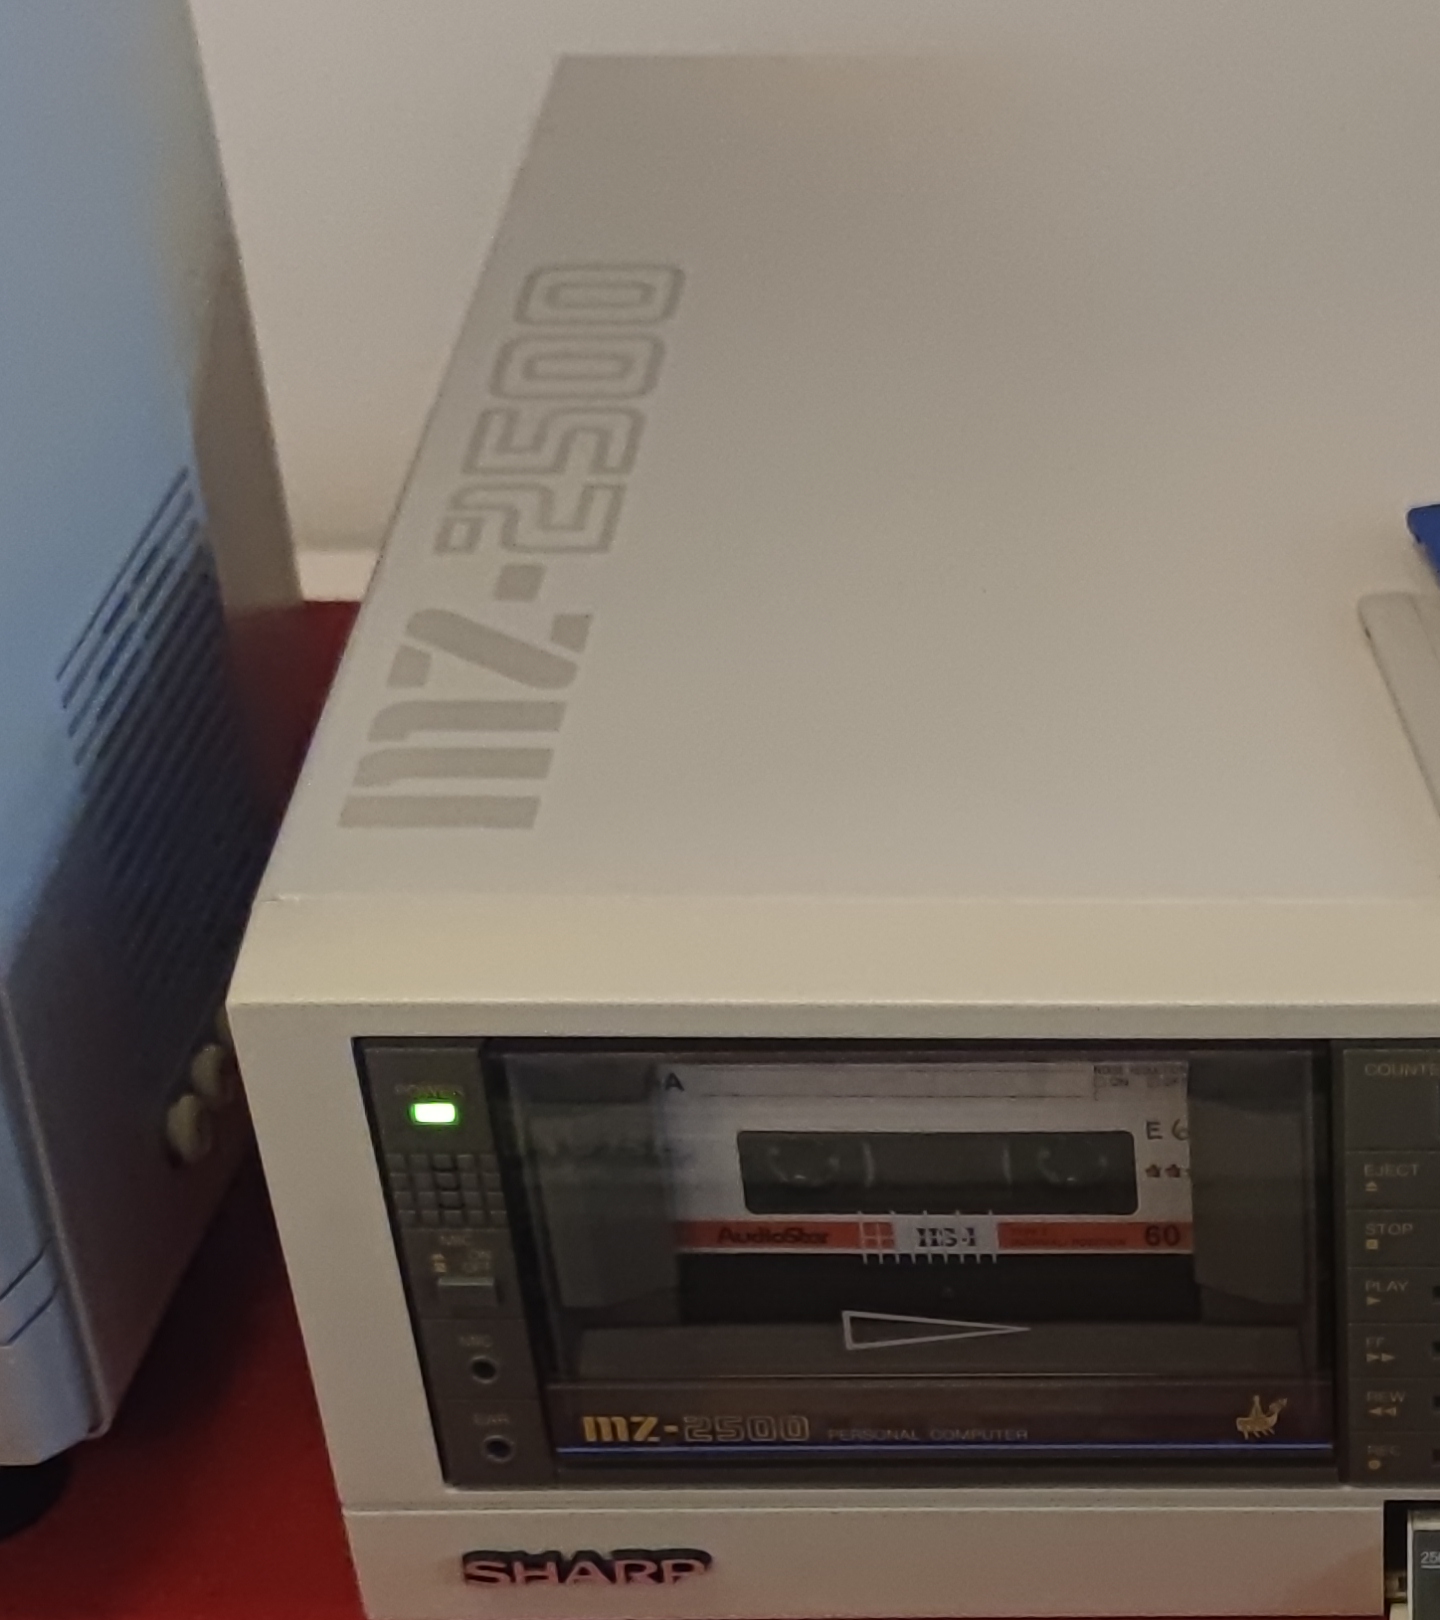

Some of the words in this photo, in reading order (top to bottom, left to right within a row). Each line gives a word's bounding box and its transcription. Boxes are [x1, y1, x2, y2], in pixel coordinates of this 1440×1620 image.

[1363, 1162, 1419, 1177] EJECT
[1144, 1223, 1182, 1247] 60
[1365, 1222, 1414, 1236] STOP
[1364, 1280, 1409, 1292] PLAY
[459, 1546, 715, 1590] SHARP
